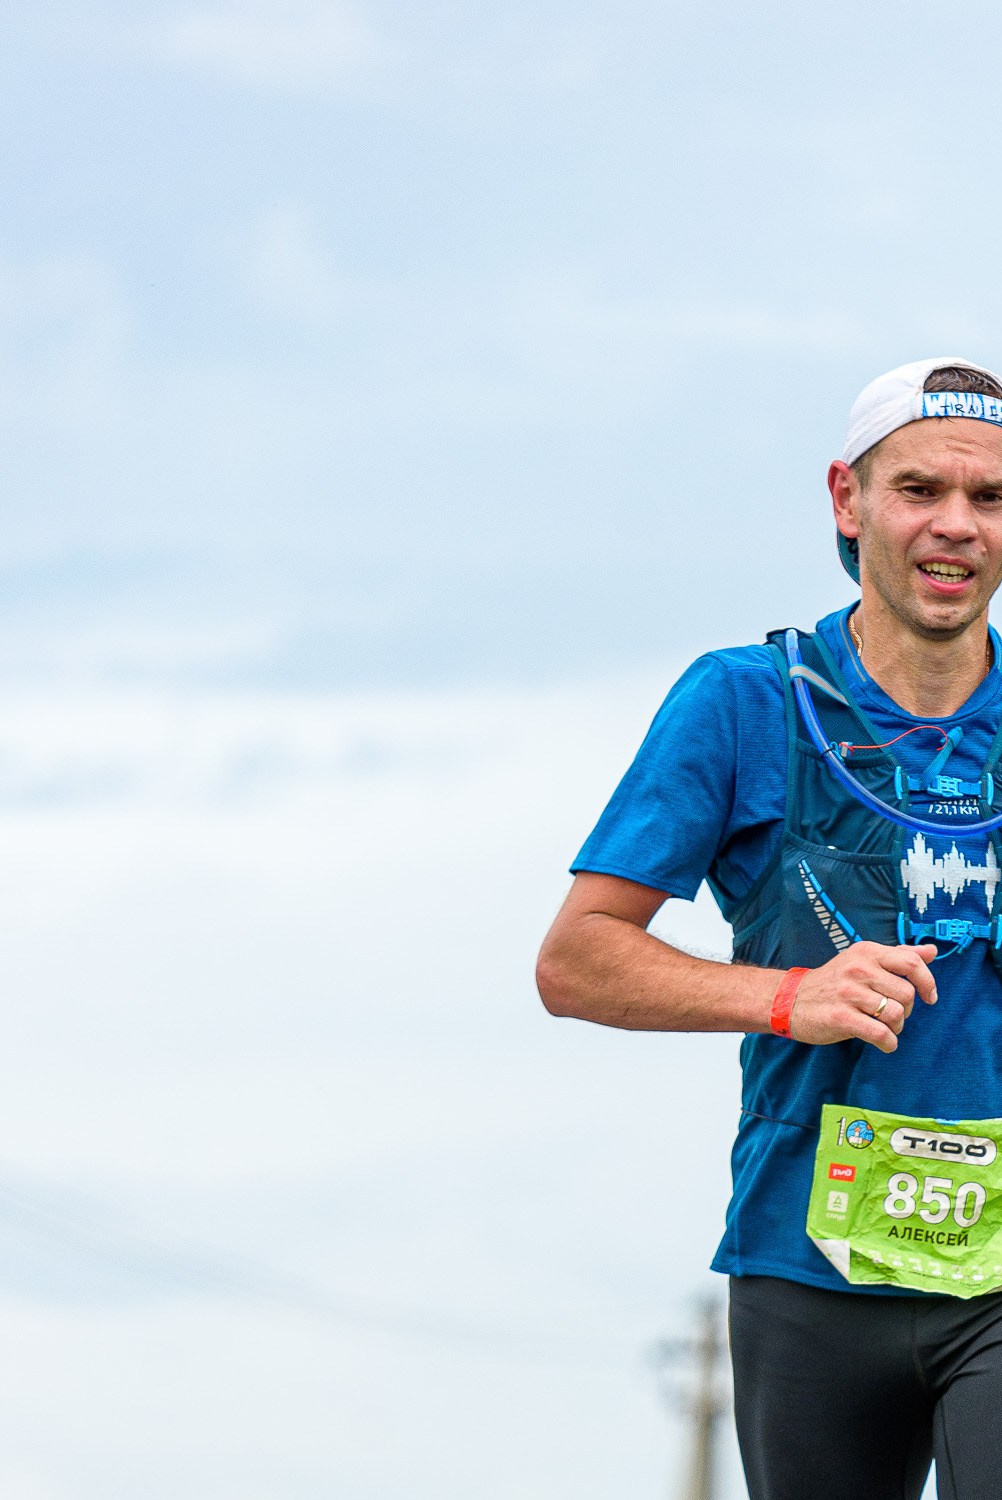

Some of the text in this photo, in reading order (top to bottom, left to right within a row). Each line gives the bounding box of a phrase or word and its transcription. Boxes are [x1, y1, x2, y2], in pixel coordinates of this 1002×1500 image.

[903, 1135, 987, 1158] T100
[883, 1171, 987, 1229] 850
[887, 1224, 970, 1247] АЛЕКСЕЙ
